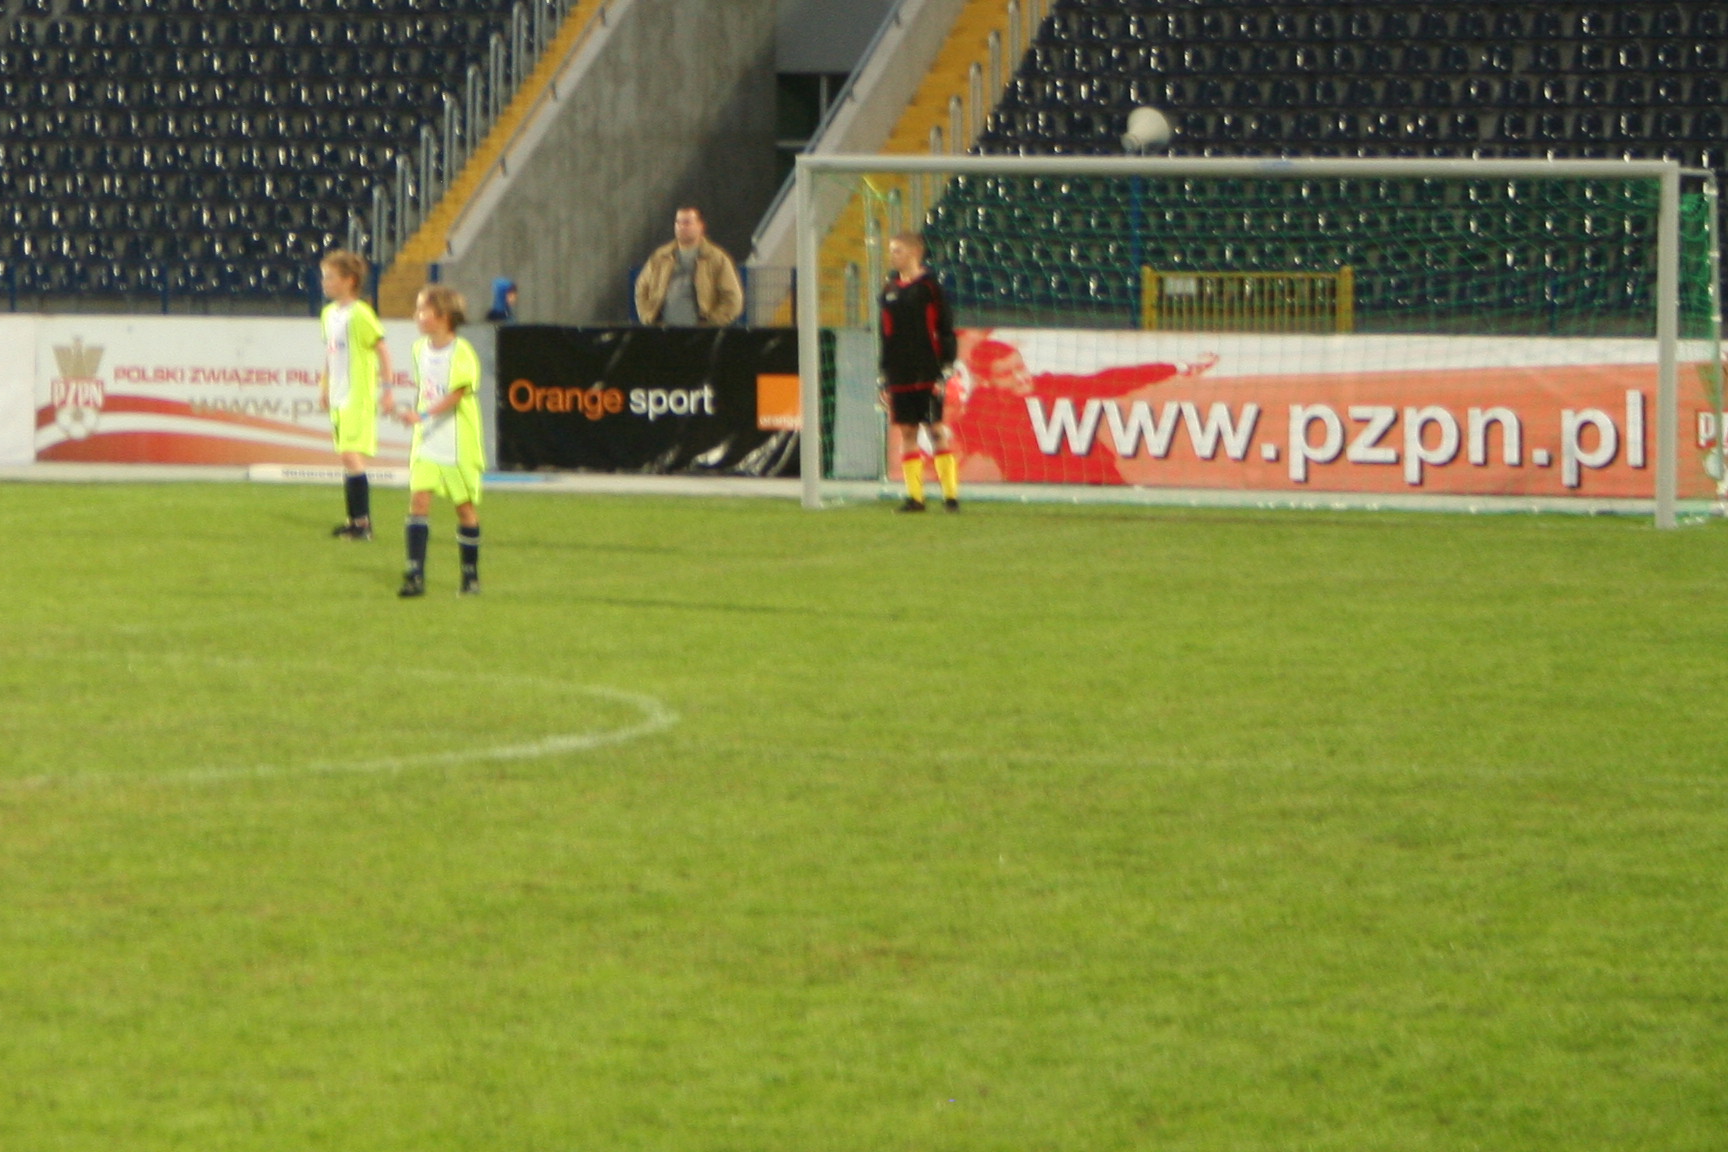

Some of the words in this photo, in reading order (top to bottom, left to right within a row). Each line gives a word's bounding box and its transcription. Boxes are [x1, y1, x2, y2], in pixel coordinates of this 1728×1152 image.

[113, 366, 184, 384] POLSKI
[508, 378, 625, 421] Orange
[629, 383, 715, 422] sport
[1025, 388, 1646, 488] www.pzpn.pl
